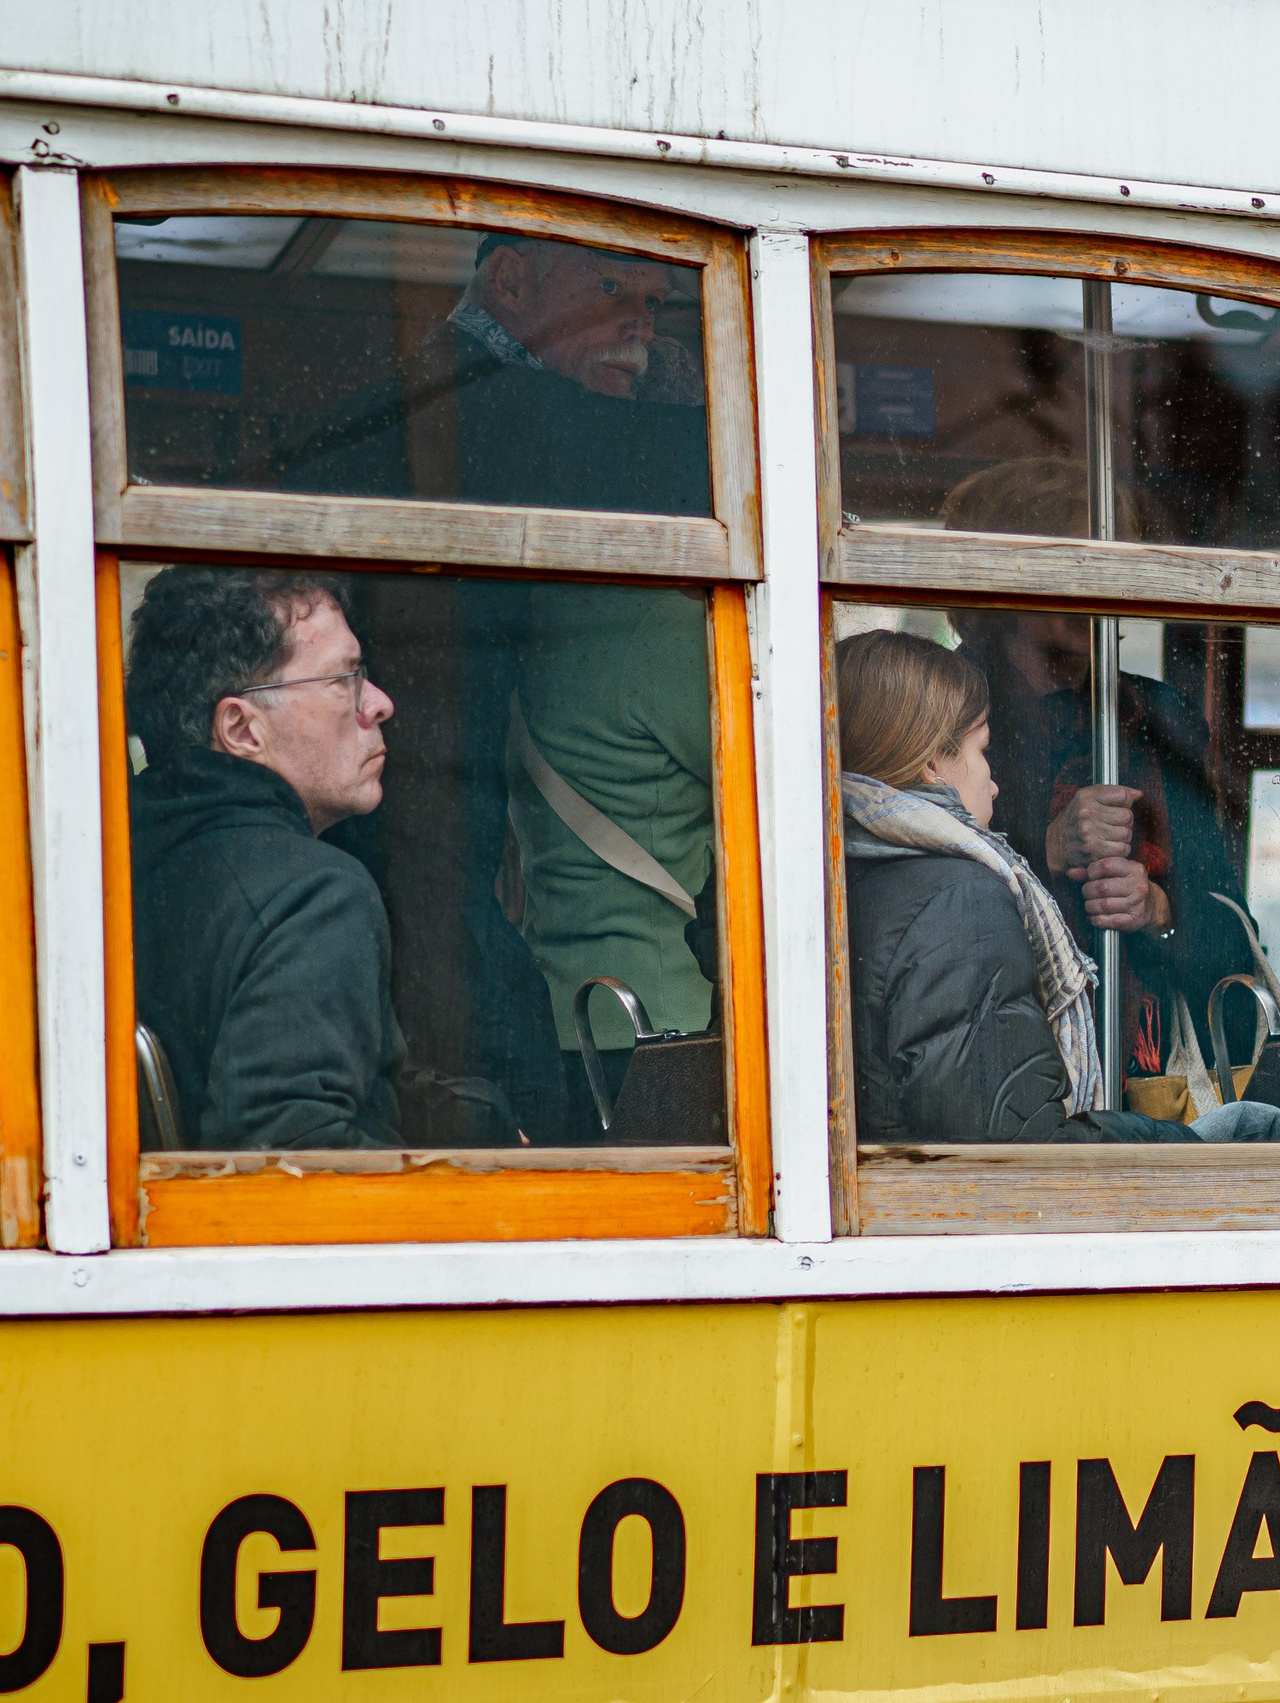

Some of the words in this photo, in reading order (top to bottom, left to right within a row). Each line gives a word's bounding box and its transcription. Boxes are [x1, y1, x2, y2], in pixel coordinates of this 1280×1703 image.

[168, 322, 235, 350] SAÍDA
[200, 1477, 687, 1678] GELO
[752, 1469, 848, 1647] E
